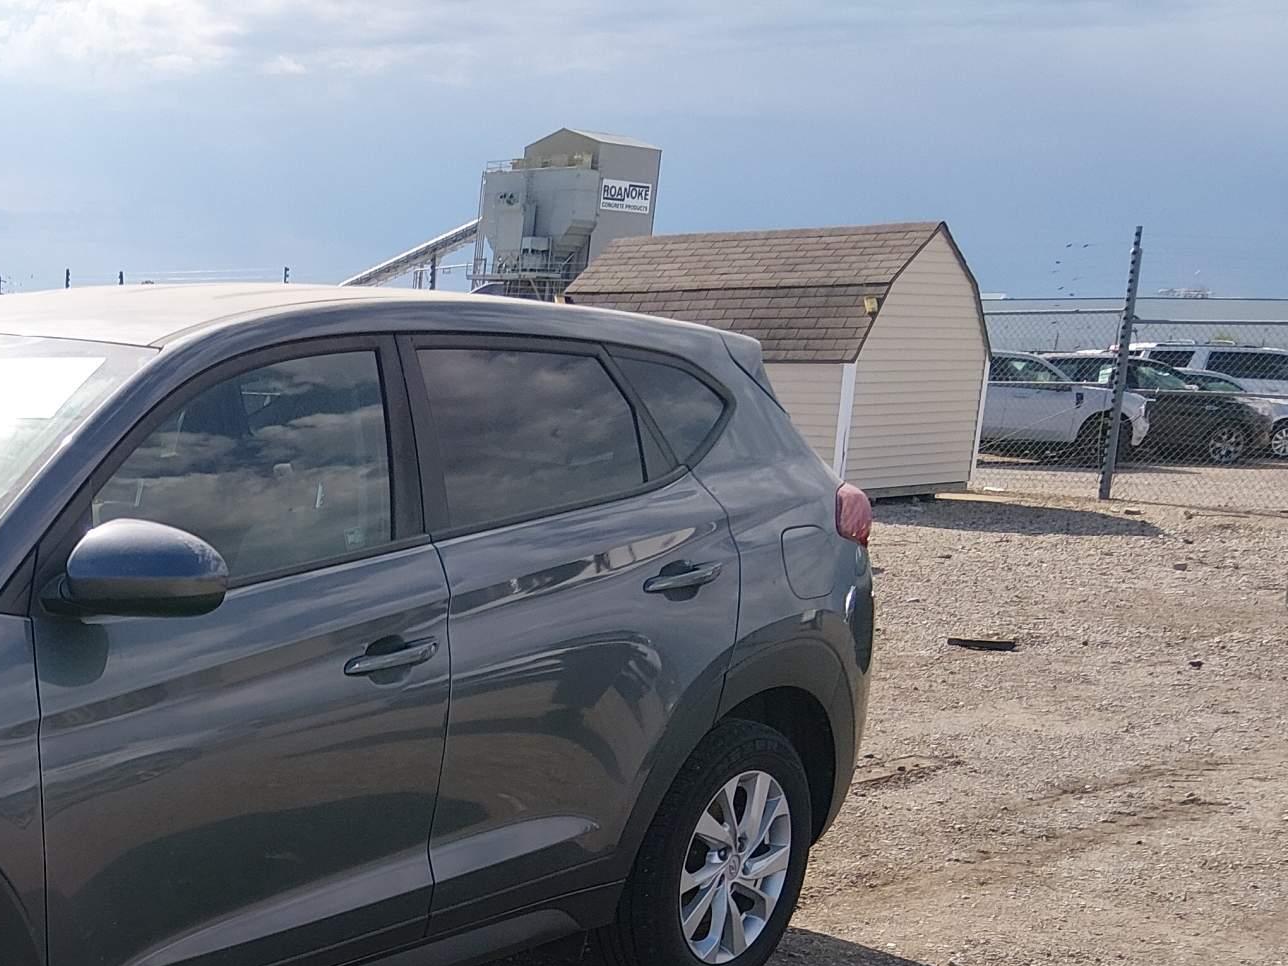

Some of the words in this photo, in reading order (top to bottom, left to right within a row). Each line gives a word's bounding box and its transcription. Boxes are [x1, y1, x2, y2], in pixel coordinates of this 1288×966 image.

[603, 184, 650, 201] ROANOKE
[601, 201, 624, 209] CONCRETE
[625, 204, 648, 212] PRODUCTS
